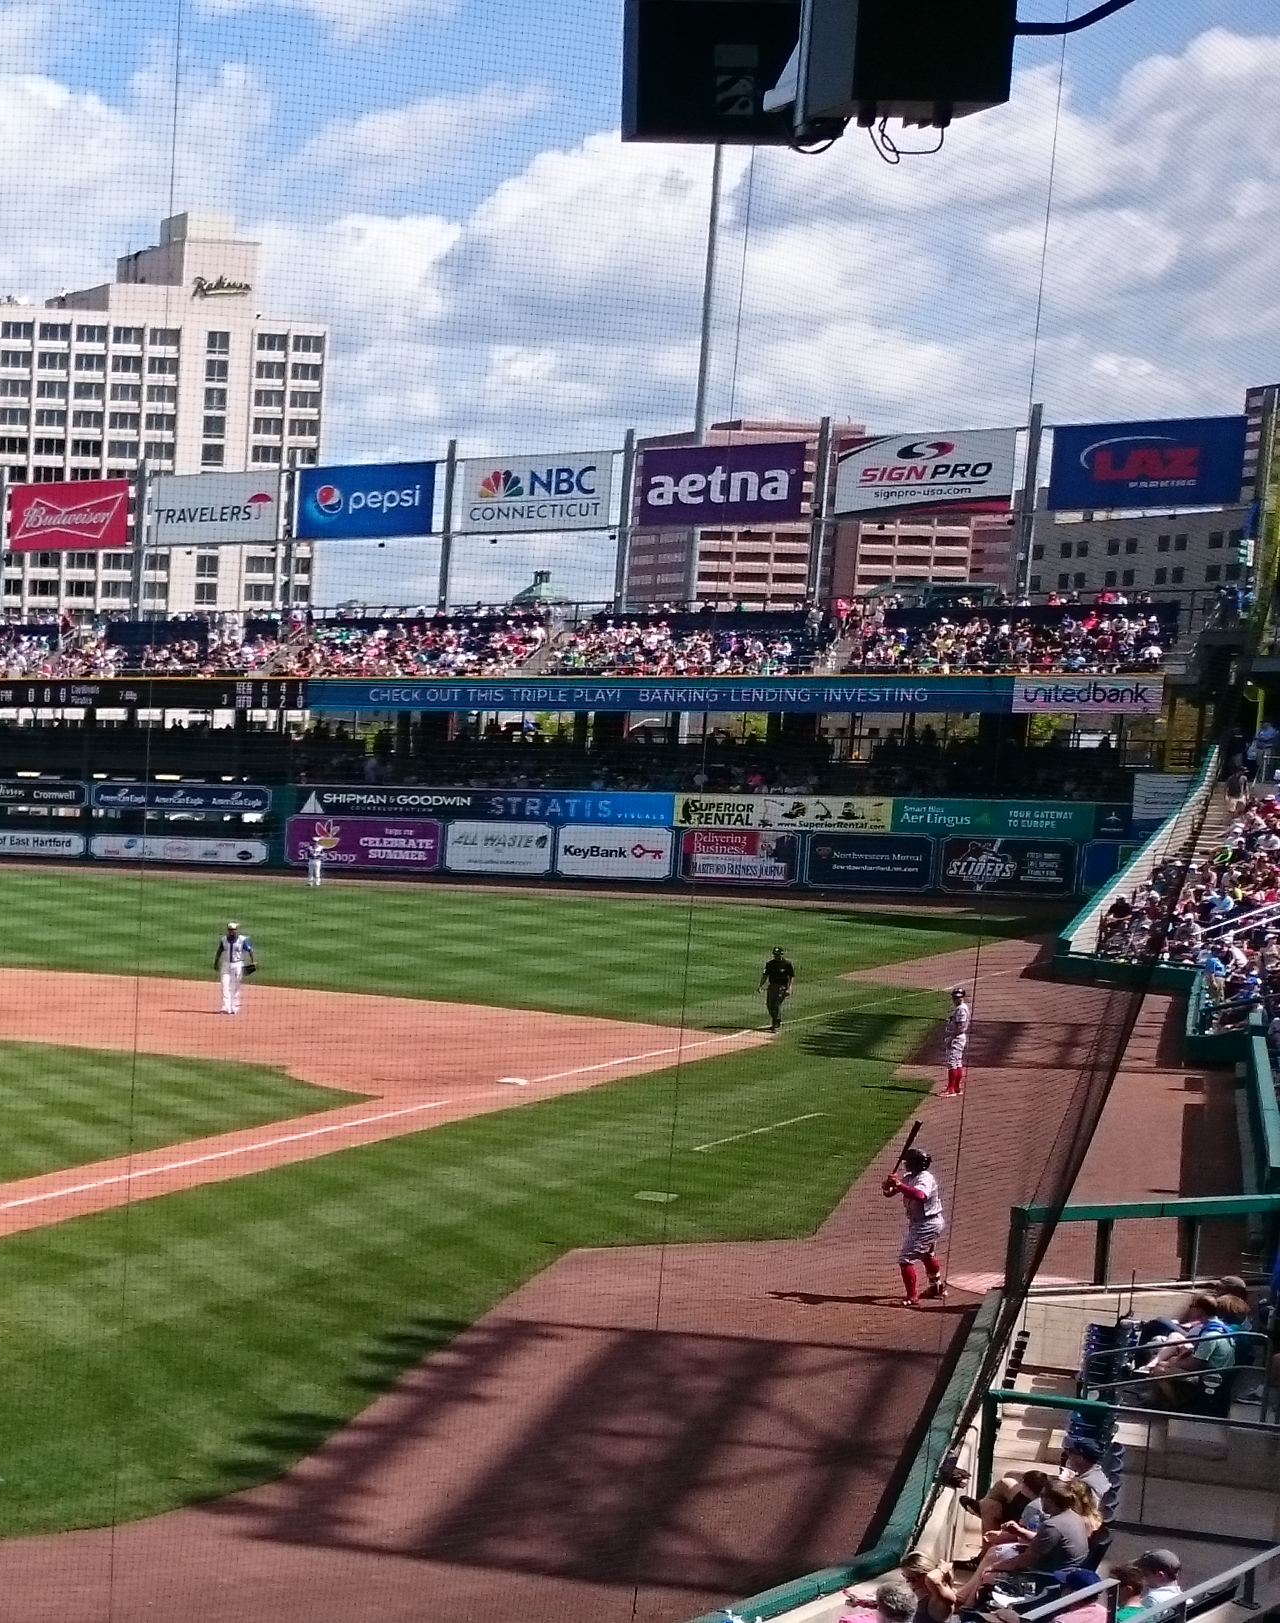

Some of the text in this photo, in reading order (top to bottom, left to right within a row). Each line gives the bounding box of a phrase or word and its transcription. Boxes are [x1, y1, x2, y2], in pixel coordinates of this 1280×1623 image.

[1093, 447, 1202, 481] LAZ
[858, 462, 993, 483] SIGN PRO
[530, 466, 597, 497] NBC
[646, 465, 790, 507] aetna
[1128, 479, 1199, 489] PARKING
[348, 484, 422, 515] pepsi
[873, 486, 972, 500] signpro-usa.com
[23, 507, 112, 529] Budweiser
[154, 504, 252, 525] TRAVELERS
[469, 502, 602, 522] CONNECTICUT
[28, 687, 67, 703] 0 0 0
[221, 693, 228, 705] 3
[368, 688, 929, 702] CHECK OUT THIS TRIPLE PLAY! BANKING LENDING INVESTING
[1023, 682, 1151, 704] unitedbank
[279, 695, 286, 709] 2
[32, 790, 76, 800] Cromwell
[322, 793, 472, 807] SHIPMAN GOODWIN
[490, 796, 666, 821] STRATIS VISUALS
[689, 799, 755, 813] SUPERIOR
[903, 805, 927, 813] Smart
[690, 812, 753, 826] RENTAL
[900, 812, 971, 828] Aer Lingus
[1007, 810, 1074, 820] YOUR GATEWAY
[777, 820, 886, 830] www.SuperiorRental.com
[1007, 819, 1057, 829] TO EUROPE
[9, 836, 30, 846] East
[32, 837, 72, 848] Hartford
[359, 836, 434, 850] CELEBRATE
[451, 835, 534, 849] ALL WASTE
[693, 831, 747, 846] Delivering
[368, 849, 428, 861] SUMMER
[563, 844, 628, 860] KeyBank
[693, 843, 748, 855] Business.
[832, 851, 923, 862] Northwestern Mutual
[692, 862, 726, 876] HARTFORD
[726, 862, 759, 876] BUSINESS
[946, 860, 1017, 879] SLIDERS
